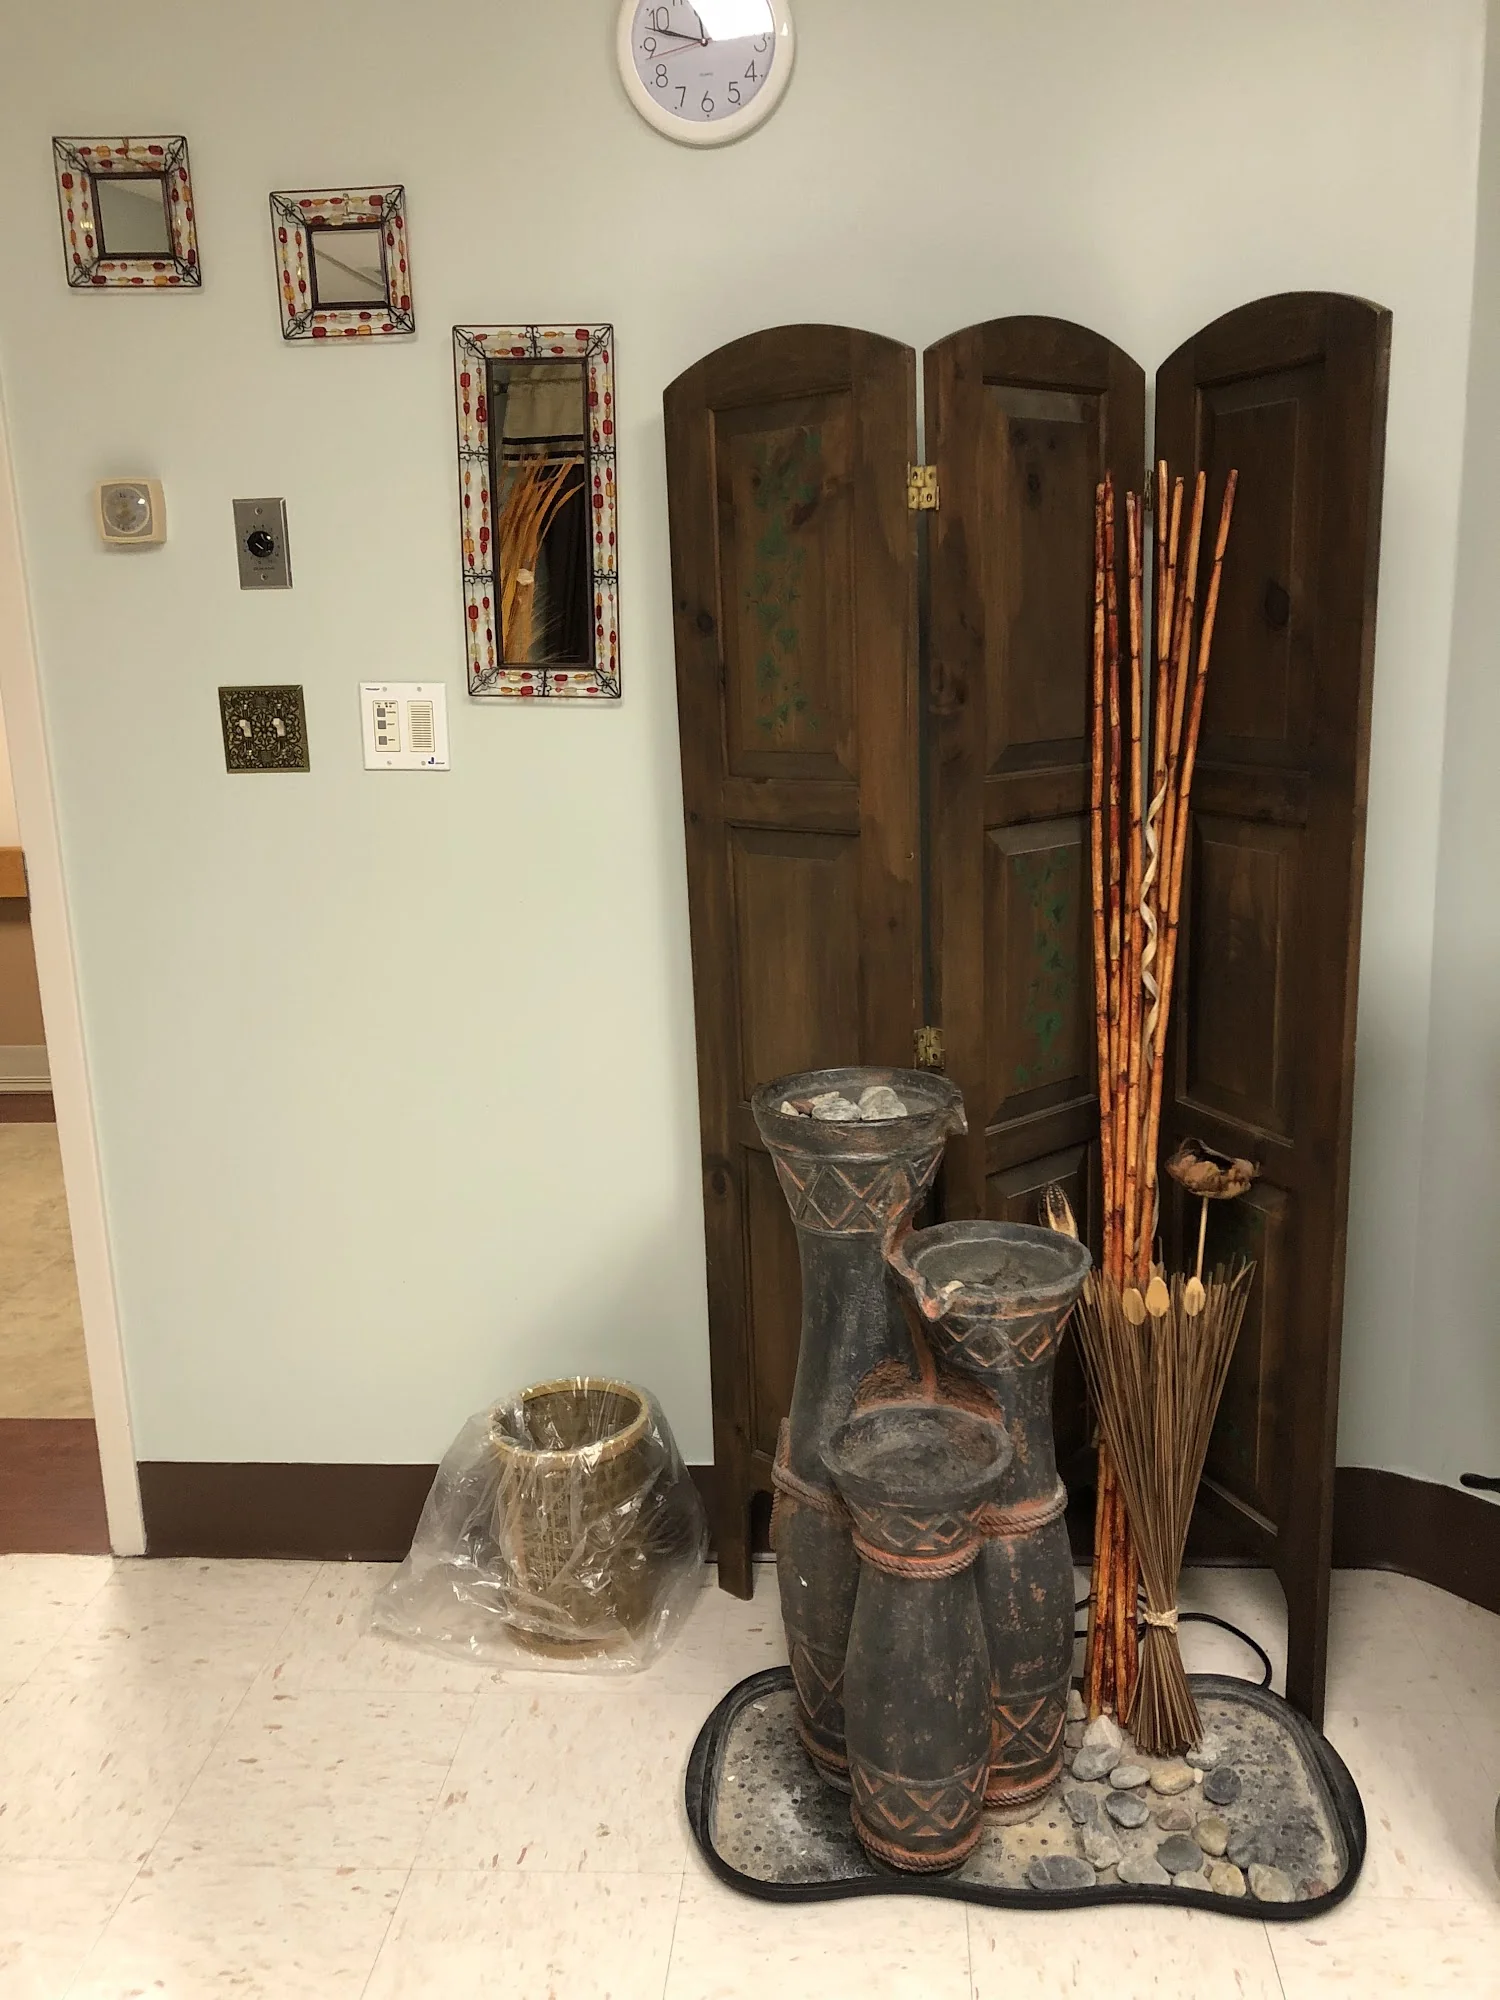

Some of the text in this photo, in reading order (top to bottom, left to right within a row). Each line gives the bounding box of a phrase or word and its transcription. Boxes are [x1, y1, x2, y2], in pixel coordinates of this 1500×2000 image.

[648, 6, 670, 32] 10
[643, 36, 657, 59] 9
[655, 63, 669, 88] 8
[744, 59, 758, 83] 4
[674, 85, 687, 108] 7
[701, 90, 715, 113] 6
[727, 81, 741, 104] 5
